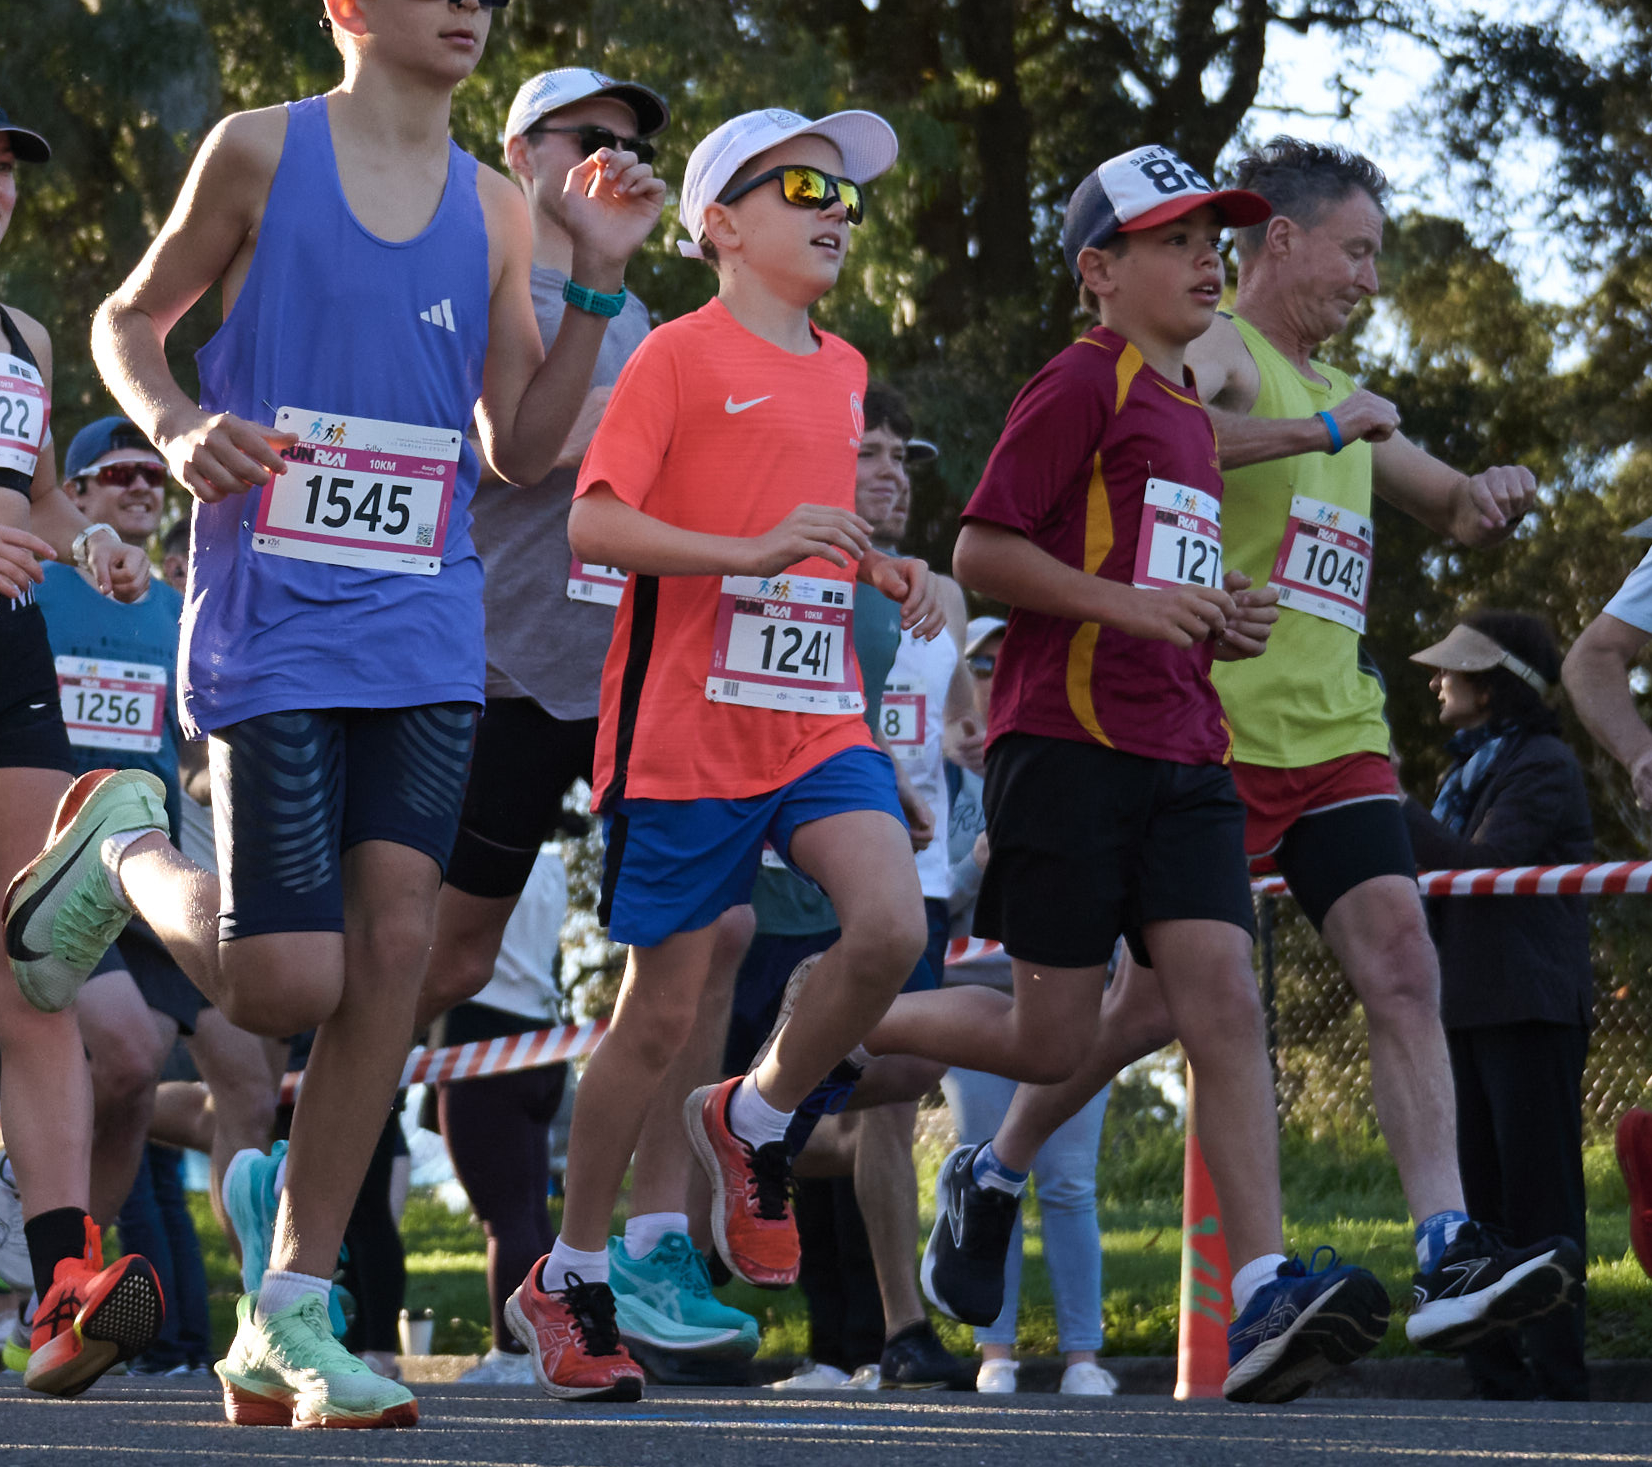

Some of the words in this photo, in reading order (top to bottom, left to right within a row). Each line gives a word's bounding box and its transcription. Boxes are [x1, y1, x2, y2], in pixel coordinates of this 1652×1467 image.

[1130, 152, 1158, 167] SAN
[314, 449, 347, 468] RUN
[370, 459, 397, 472] 10KM
[305, 475, 413, 536] 1545
[1176, 536, 1223, 588] 127
[1303, 544, 1364, 598] 1043
[763, 603, 792, 620] RUN
[804, 610, 823, 621] 10KM
[760, 624, 832, 677] 1241
[76, 691, 141, 726] 1256
